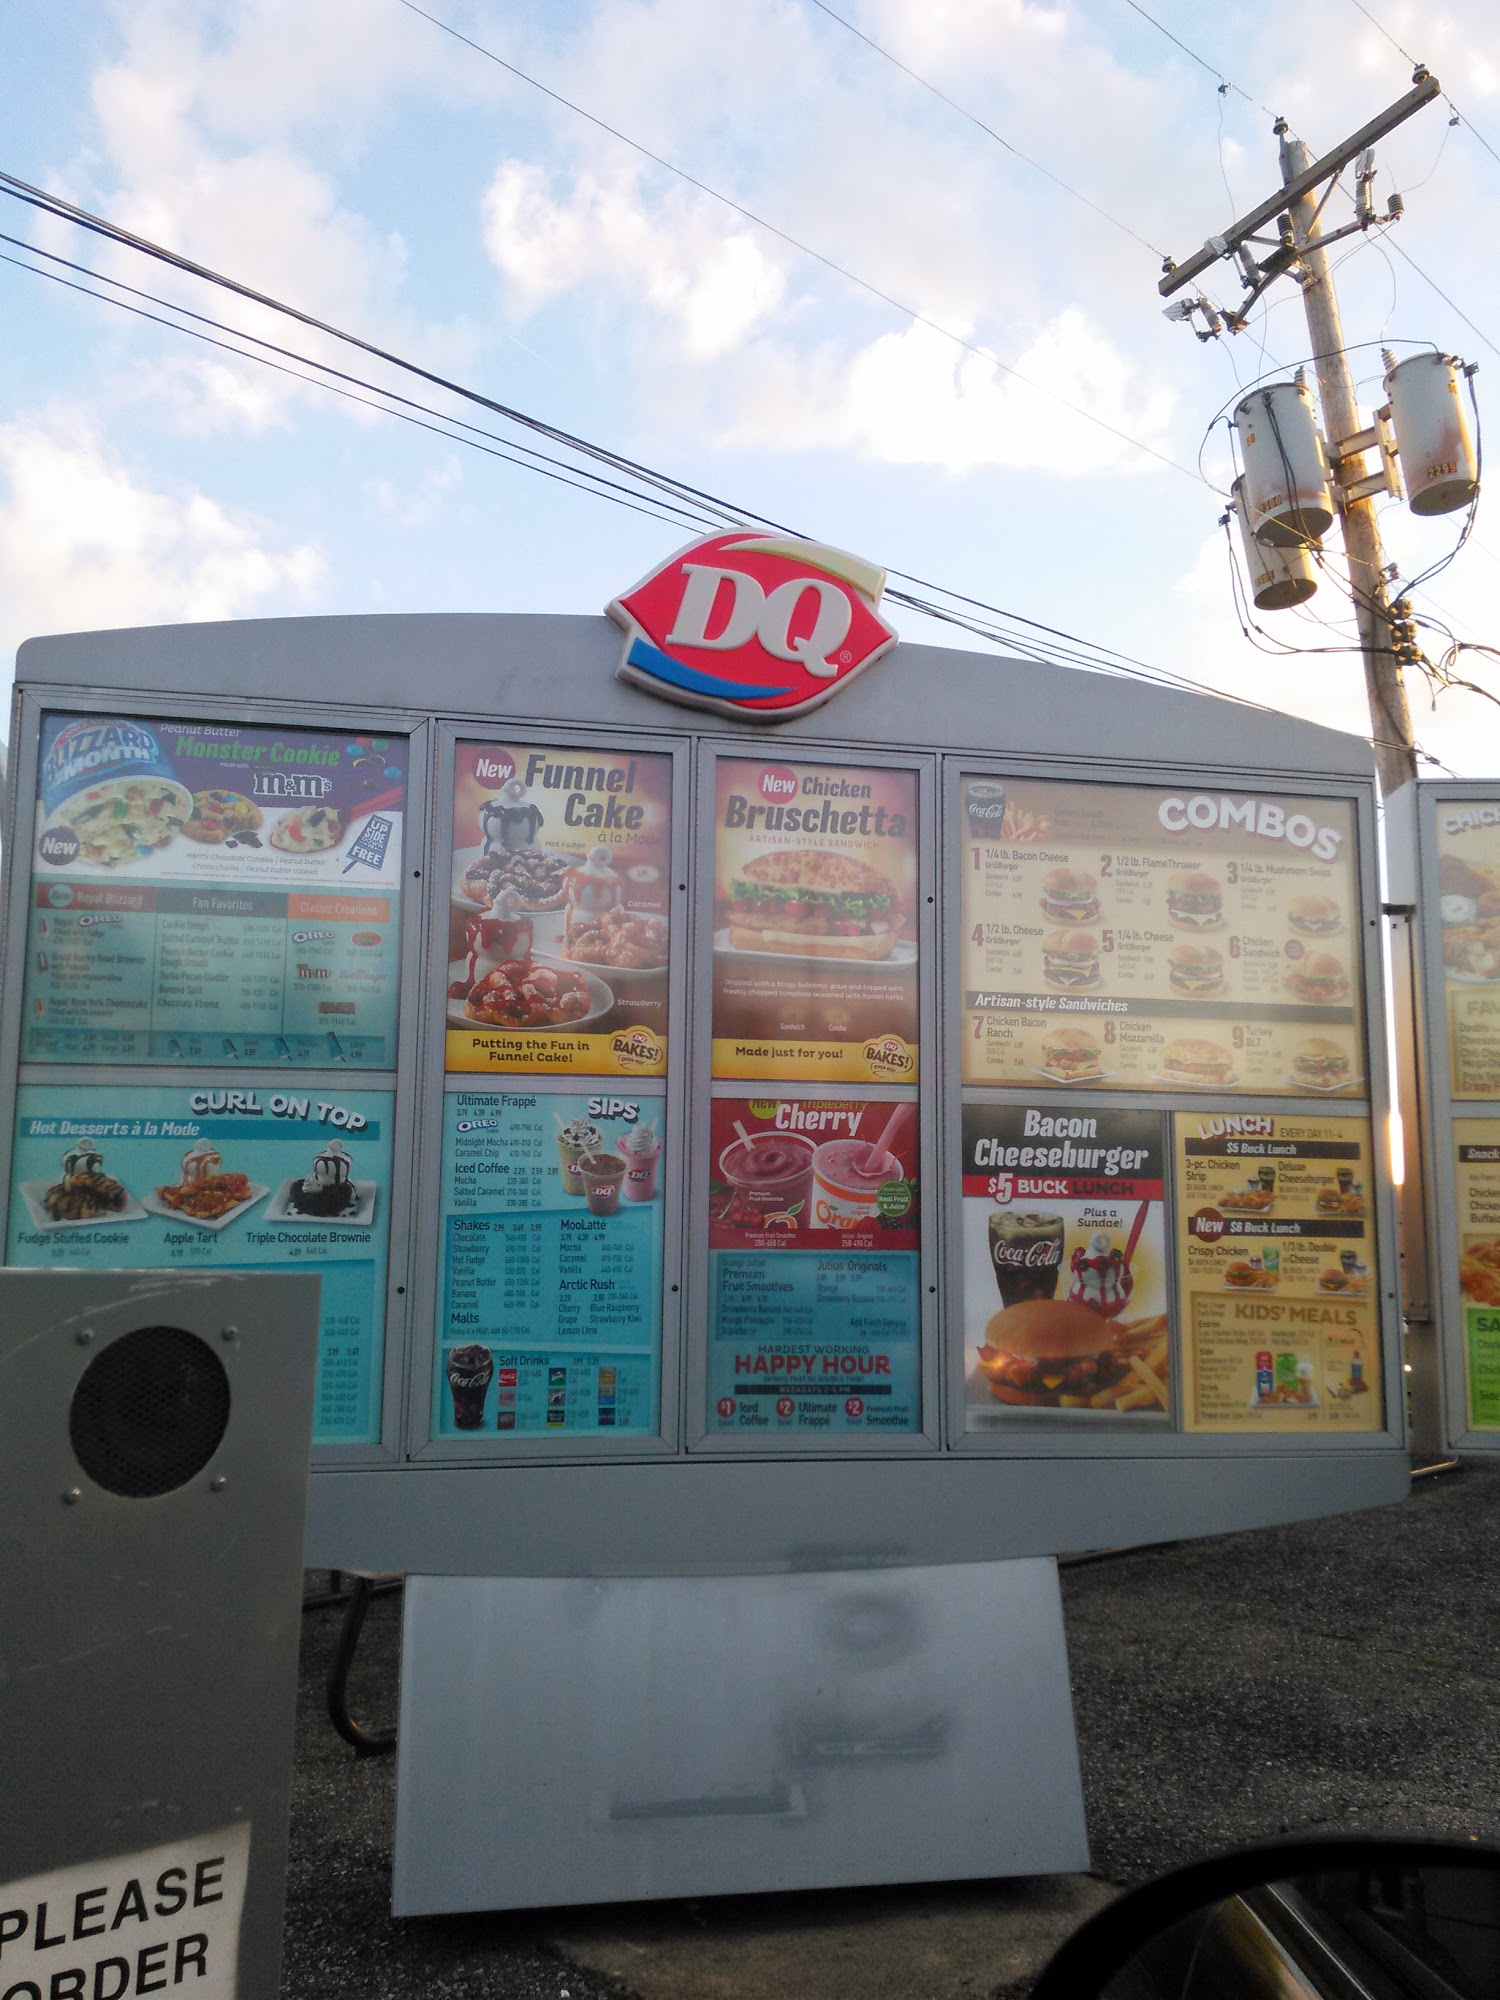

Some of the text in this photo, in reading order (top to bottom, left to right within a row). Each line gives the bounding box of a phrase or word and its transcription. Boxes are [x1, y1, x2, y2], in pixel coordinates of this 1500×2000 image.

[1428, 462, 1457, 478] 2299
[665, 563, 839, 678] DQ
[176, 735, 342, 767] Monster Cookie
[66, 746, 151, 778] MONTH
[476, 758, 512, 779] New
[525, 754, 638, 793] Funnel
[763, 774, 872, 799] New Chicken
[564, 793, 644, 830] Cake
[725, 795, 907, 838] Bruschetta
[371, 820, 388, 833] UP
[1157, 796, 1344, 864] COMBOS
[364, 828, 387, 844] SIDE
[40, 836, 77, 856] New
[351, 845, 382, 864] FREE
[971, 847, 1069, 870] 1 1/4 lb. Bacon Cheese
[1100, 854, 1201, 878] 2 1/2 lb. FlameThrower
[1226, 861, 1239, 884] 3
[1241, 863, 1253, 873] 1/4
[1254, 864, 1264, 873] lb.
[193, 898, 253, 910] Fan Favorites
[300, 902, 377, 916] Classic Creations
[293, 930, 335, 944] OREO
[971, 923, 1044, 947] 4 1/2 lb. Cheese
[1102, 929, 1174, 953] 5 1/4 lb. Cheese
[617, 998, 661, 1008] Strawberry
[975, 993, 1129, 1013] Artisan-style Sandwiches
[972, 1015, 1046, 1040] 7 Chicken Bacon
[986, 1027, 1013, 1039] Ranch
[1103, 1020, 1152, 1044] 8 Chicken
[472, 1038, 590, 1051] Putting the Fun in
[1119, 1032, 1165, 1045] Mozzarella
[489, 1052, 573, 1063] Funnel Cake!
[613, 1039, 659, 1062] BAKES!
[736, 1046, 844, 1060] Made just for you!
[866, 1047, 910, 1069] BAKES!
[456, 1094, 537, 1109] Ultimate Frappé
[188, 1089, 368, 1133] CURL ON TOP
[587, 1096, 640, 1123] SIPS
[456, 1119, 499, 1133] OREO
[775, 1103, 863, 1137] Cherry
[1024, 1109, 1097, 1138] Bacon
[1197, 1115, 1273, 1140] LUNCH
[1280, 1128, 1307, 1139] EVERY
[29, 1119, 200, 1137] Hot Desserts à la Mode
[455, 1137, 509, 1149] Midnight Mocha
[1226, 1142, 1297, 1155] $5 Buck Lunch
[974, 1138, 1149, 1176] Cheeseburger
[454, 1177, 477, 1186] Mocha
[988, 1172, 1135, 1203] $5 BUCK LUNCH
[453, 1198, 478, 1207] Vanilla
[1083, 1207, 1117, 1218] Plus a
[454, 1219, 490, 1231] Shakes
[561, 1218, 606, 1231] MooLatté
[1077, 1217, 1122, 1229] Sundae!
[1196, 1217, 1300, 1235] New $6 Buck Lunch
[18, 1232, 130, 1247] Fudge Stuffed Cookie
[163, 1232, 219, 1247] Apple Tart
[246, 1231, 371, 1247] Triple Chocolate Brownie
[453, 1233, 486, 1242] Chocolate
[560, 1243, 582, 1252] Mocha
[994, 1239, 1061, 1268] Coca-Cola
[1188, 1246, 1248, 1258] Crispy Chicken
[559, 1254, 588, 1263] Caramel
[559, 1265, 583, 1274] Vanilla
[722, 1268, 765, 1279] Premium
[559, 1279, 588, 1290] Arctic
[590, 1279, 615, 1290] Rush
[722, 1280, 794, 1292] Fruit Smoothies
[558, 1304, 581, 1314] Cherry
[590, 1304, 640, 1314] Blue Raspberry
[1235, 1303, 1286, 1321] KIDS'
[1289, 1308, 1357, 1326] MEALS
[451, 1312, 480, 1324] Malts
[558, 1315, 578, 1326] Grape
[759, 1345, 870, 1354] HARDEST WORKING
[500, 1356, 550, 1366] Soft Drinks
[735, 1354, 892, 1375] HAPPY HOUR
[721, 1401, 759, 1415] $1 Iced
[779, 1401, 838, 1415] $2 Ultimate
[739, 1415, 769, 1426] Coffee
[799, 1415, 831, 1428] Frappé
[866, 1415, 909, 1427] Smoothie
[0, 1856, 226, 1960] PLEASE
